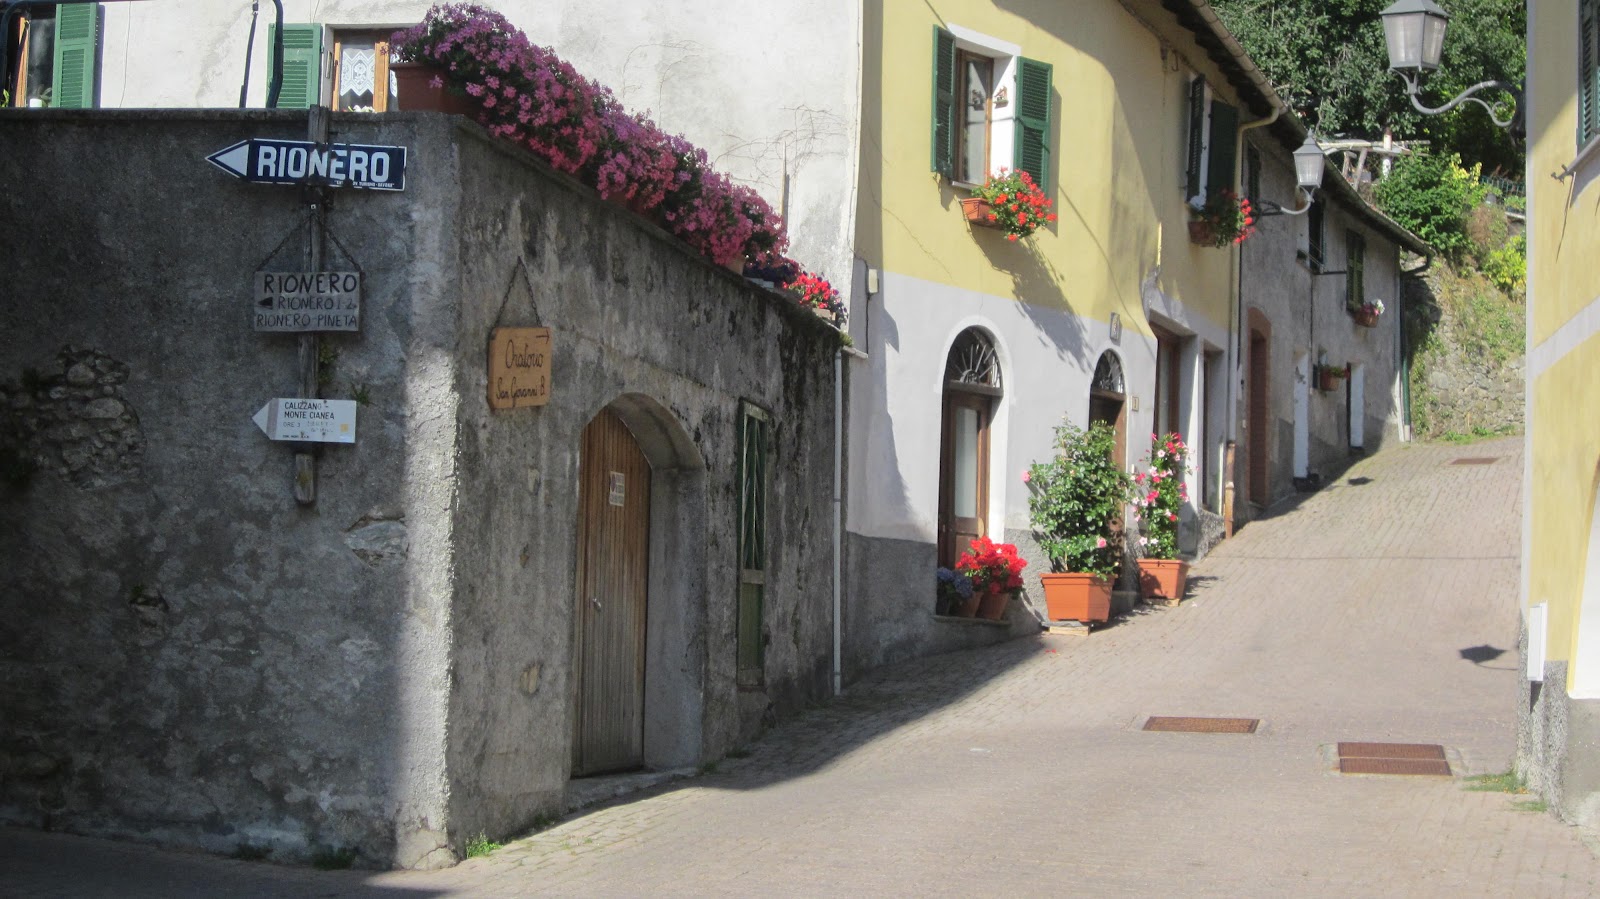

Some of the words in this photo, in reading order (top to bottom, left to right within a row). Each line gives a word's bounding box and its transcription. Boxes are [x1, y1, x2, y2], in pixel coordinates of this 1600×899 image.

[257, 145, 390, 183] RIONERO
[263, 273, 357, 294] RIONERO
[278, 296, 334, 311] RIONERO
[505, 339, 544, 369] Oratorio
[496, 376, 509, 400] San
[284, 411, 307, 419] MONTE
[309, 411, 335, 420] CIANEA
